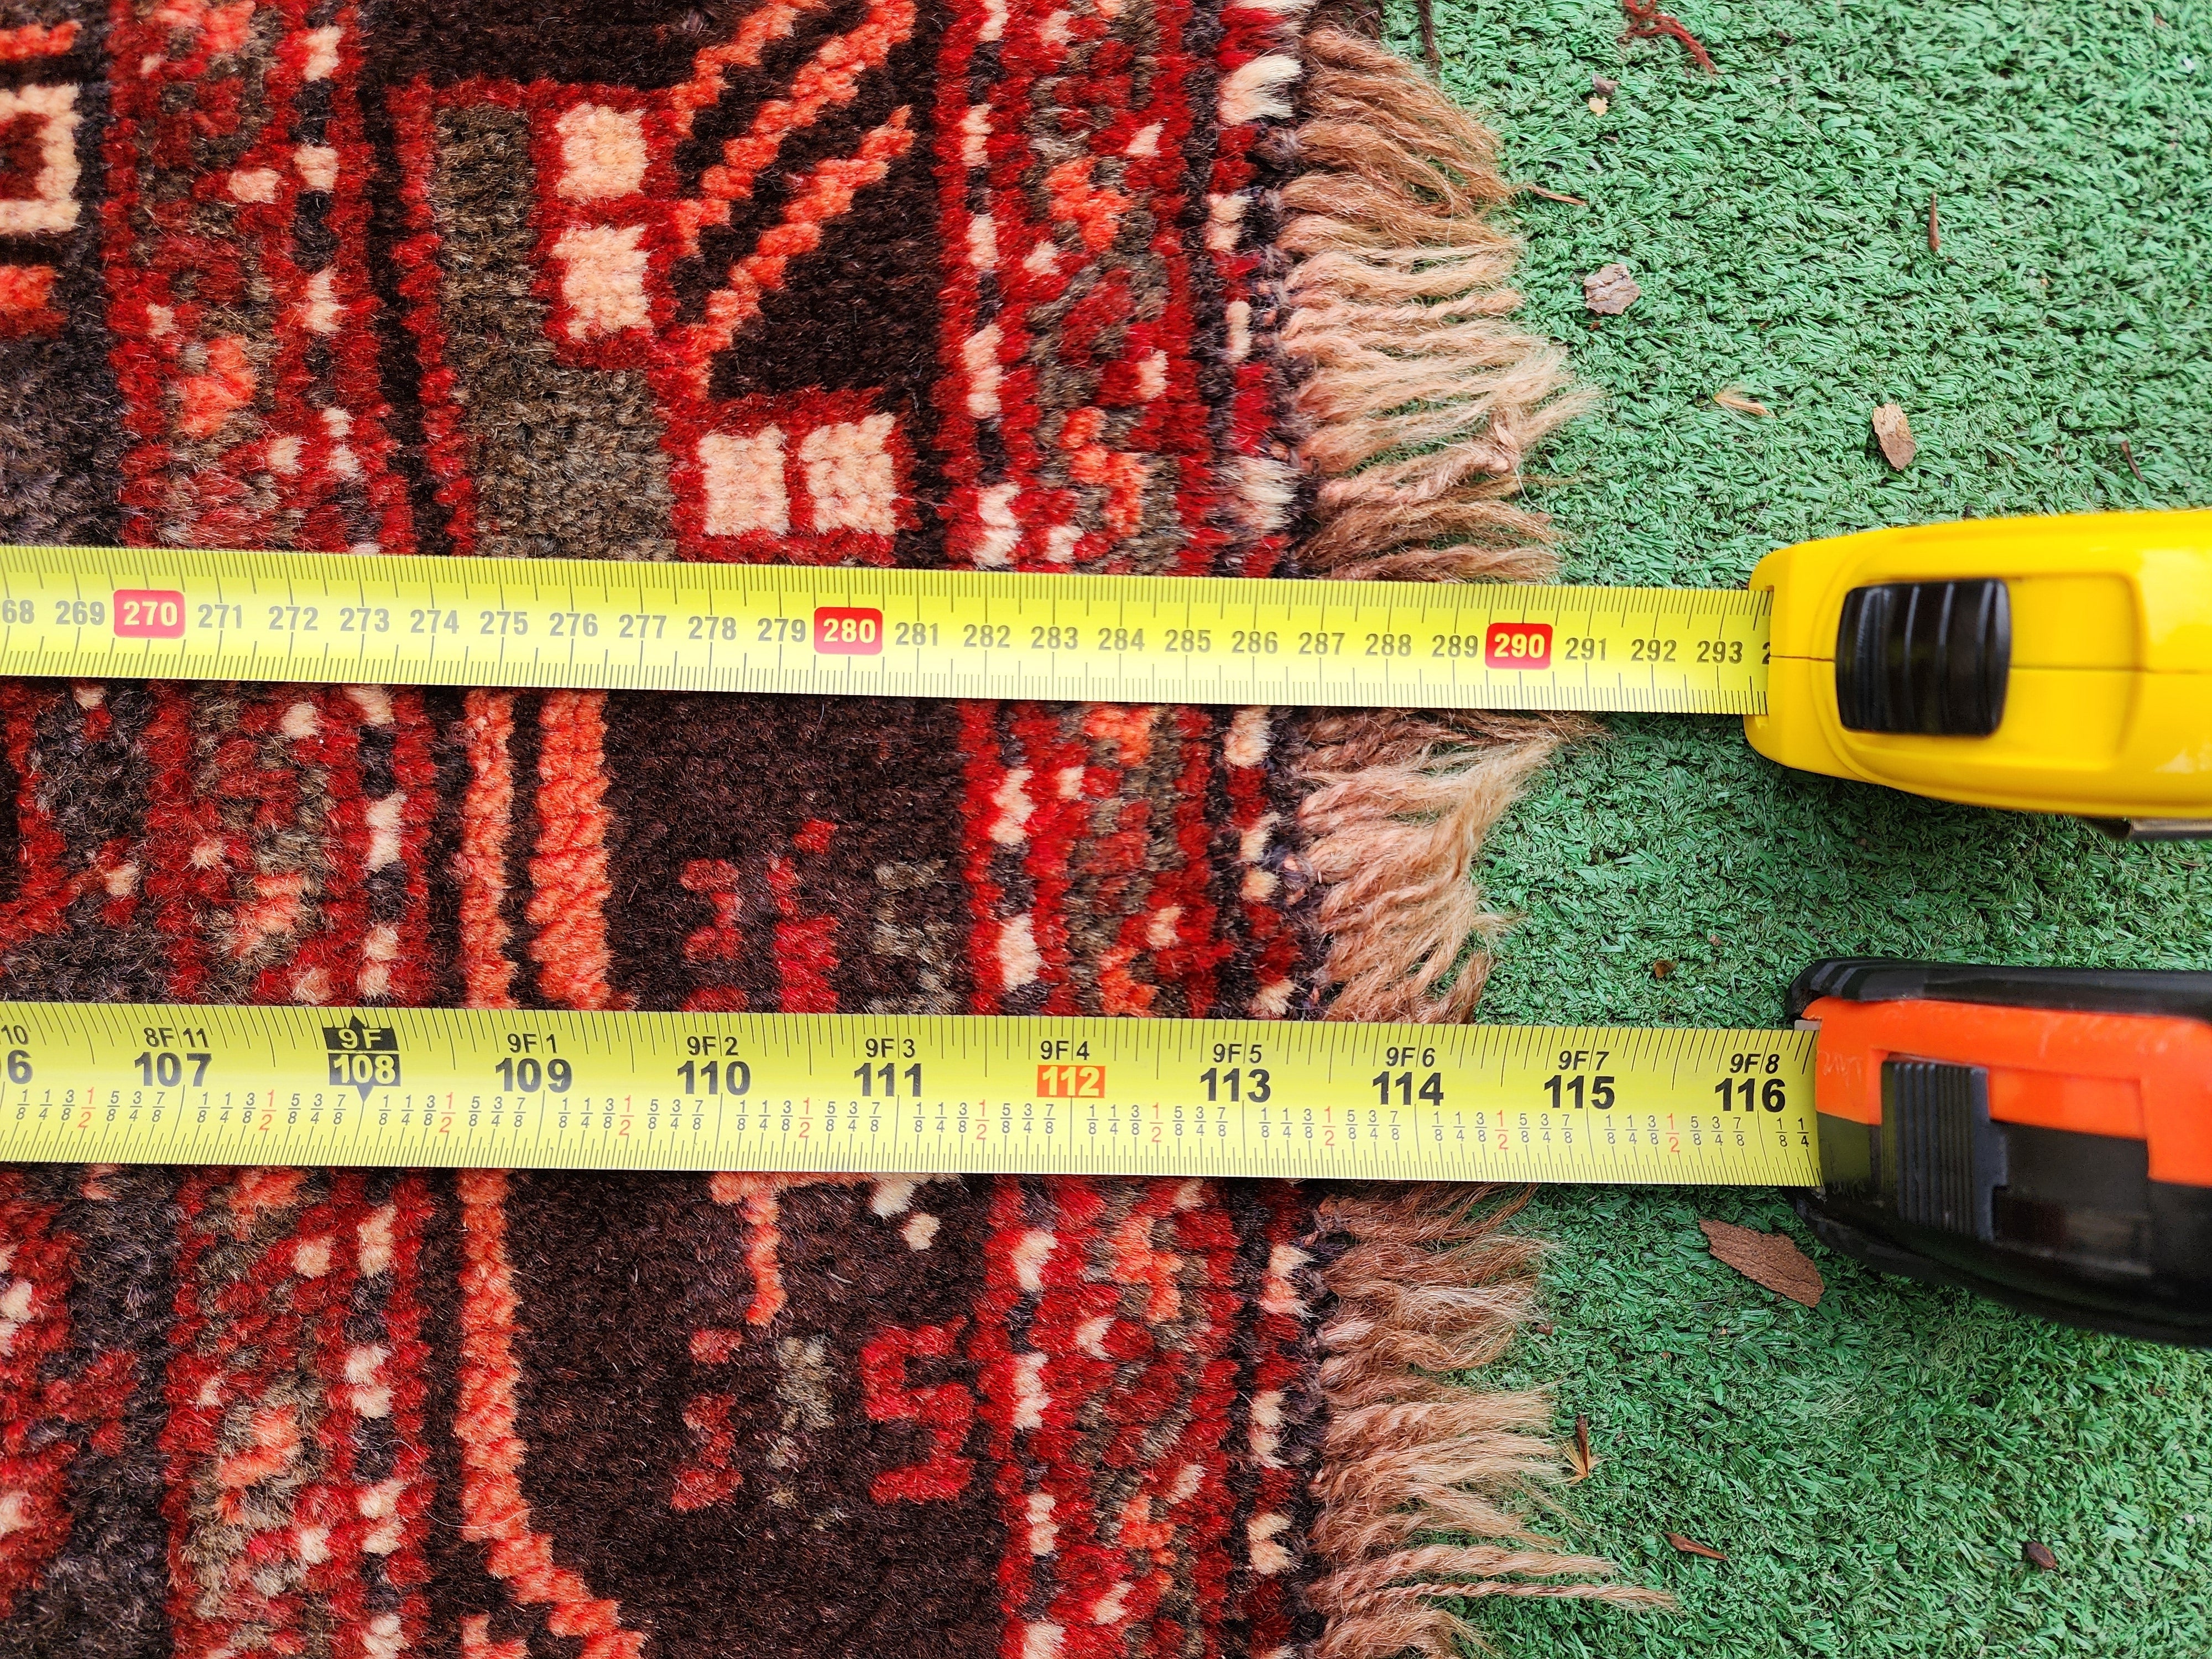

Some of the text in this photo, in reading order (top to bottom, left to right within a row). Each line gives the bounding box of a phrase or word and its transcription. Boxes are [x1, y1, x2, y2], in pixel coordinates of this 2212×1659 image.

[56, 601, 105, 625] 269
[123, 601, 178, 626] 270
[199, 604, 242, 628] 271
[269, 606, 317, 630] 272
[340, 608, 389, 632] 273
[411, 610, 459, 633] 274
[481, 611, 528, 634] 275
[550, 613, 598, 637] 276
[619, 614, 666, 638] 277
[688, 616, 736, 640] 278
[758, 618, 805, 642] 279
[823, 618, 876, 643] 280
[895, 622, 937, 645] 281
[964, 624, 1010, 648] 282
[1031, 627, 1078, 649] 283
[1098, 628, 1145, 651] 284
[1165, 629, 1211, 652] 285
[1232, 631, 1277, 653] 286
[1299, 633, 1345, 655] 287
[1366, 634, 1411, 656] 288
[1432, 635, 1478, 658] 289
[1494, 633, 1545, 658] 290
[1566, 638, 1606, 660] 291
[1631, 639, 1676, 662] 292
[1697, 641, 1743, 664] 293
[134, 1052, 212, 1087] 107
[333, 1055, 395, 1084] 108
[495, 1057, 572, 1093] 109
[677, 1061, 750, 1095] 110
[854, 1062, 921, 1097] 111
[1042, 1066, 1100, 1097] 112
[1199, 1068, 1271, 1103] 113
[1372, 1071, 1444, 1106] 114
[1543, 1075, 1615, 1110] 115
[1715, 1078, 1785, 1113] 116
